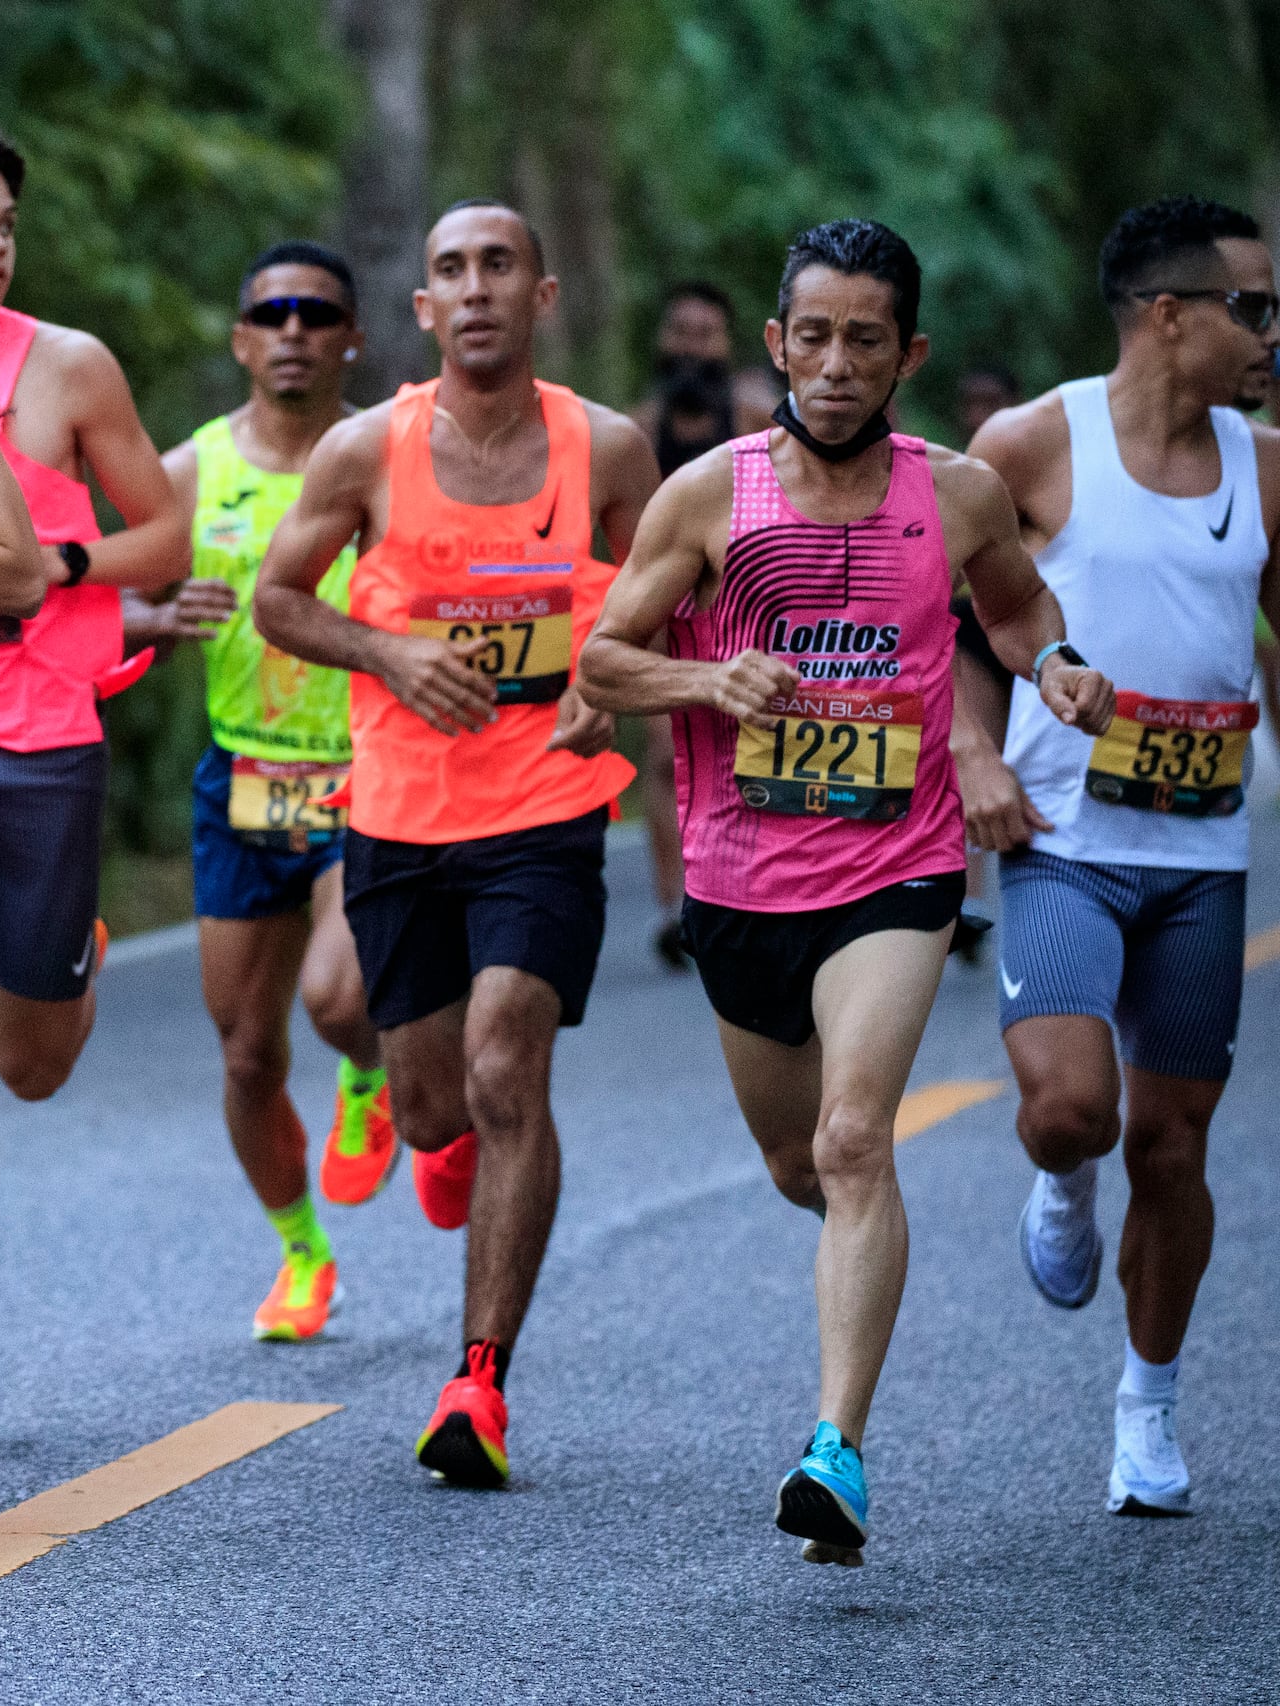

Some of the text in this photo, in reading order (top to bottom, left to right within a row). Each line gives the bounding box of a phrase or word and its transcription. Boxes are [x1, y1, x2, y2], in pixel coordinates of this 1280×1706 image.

[437, 602, 488, 618] SAN
[771, 619, 900, 654] Lolitos
[797, 660, 901, 680] RUNNING
[771, 696, 824, 716] SAN
[828, 700, 894, 720] BLAS
[772, 718, 888, 786] 1221
[1132, 727, 1224, 786] 533
[827, 790, 857, 802] hello
